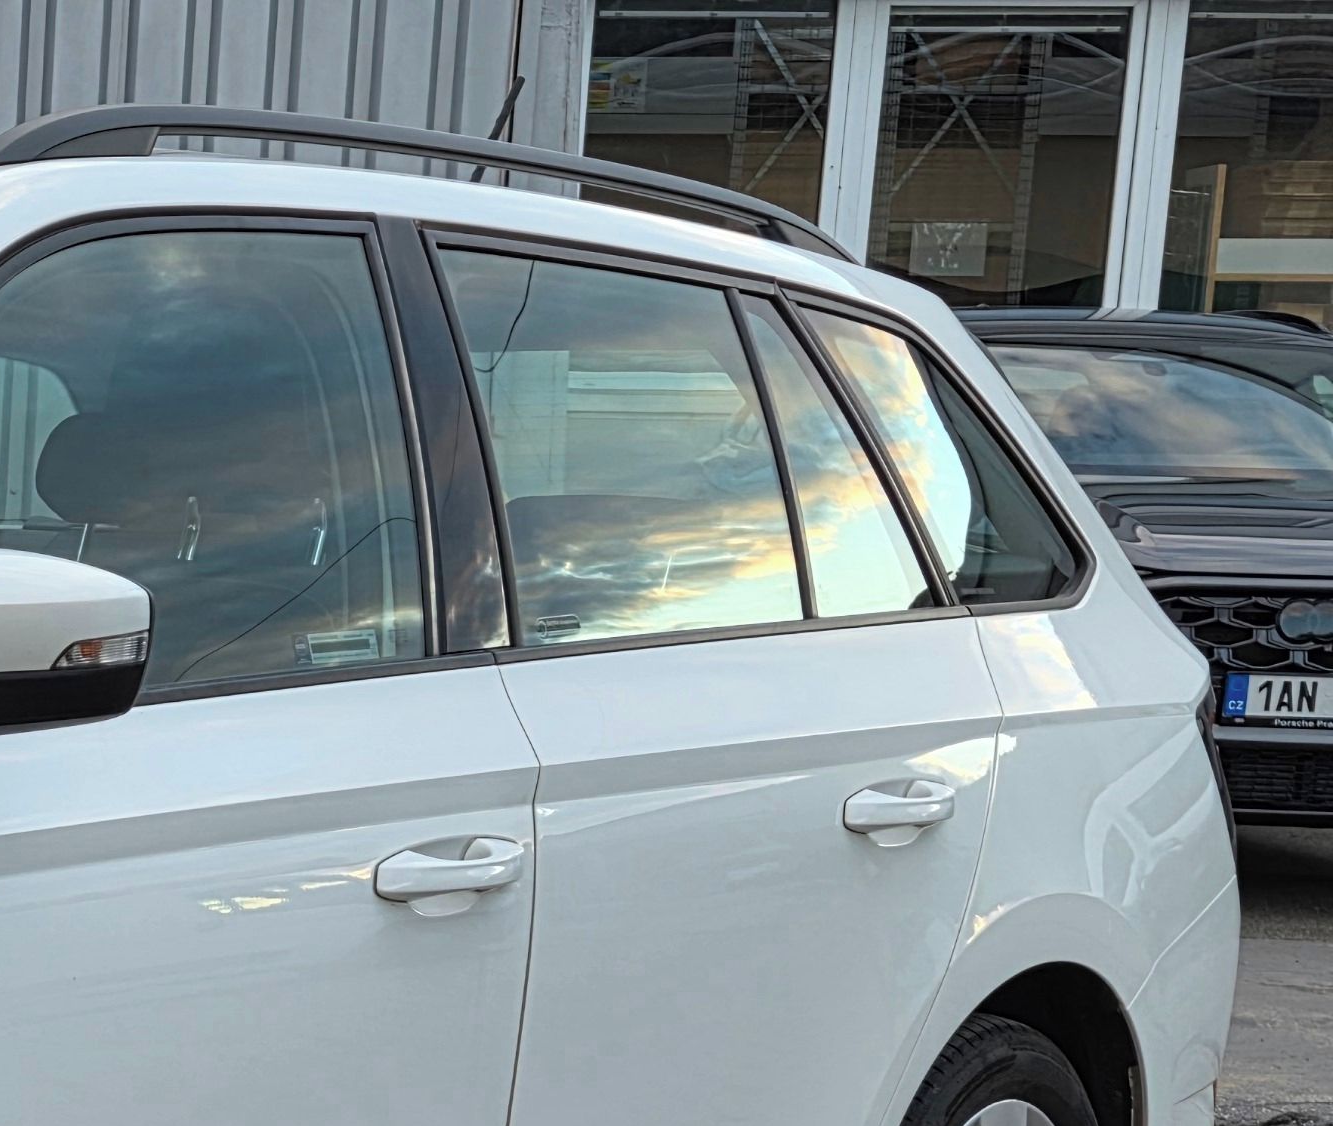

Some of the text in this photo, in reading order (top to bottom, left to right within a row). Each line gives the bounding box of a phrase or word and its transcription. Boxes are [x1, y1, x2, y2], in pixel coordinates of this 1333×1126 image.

[1258, 680, 1318, 712] 1AN
[1228, 700, 1244, 710] CZ
[1274, 718, 1315, 728] Porsche
